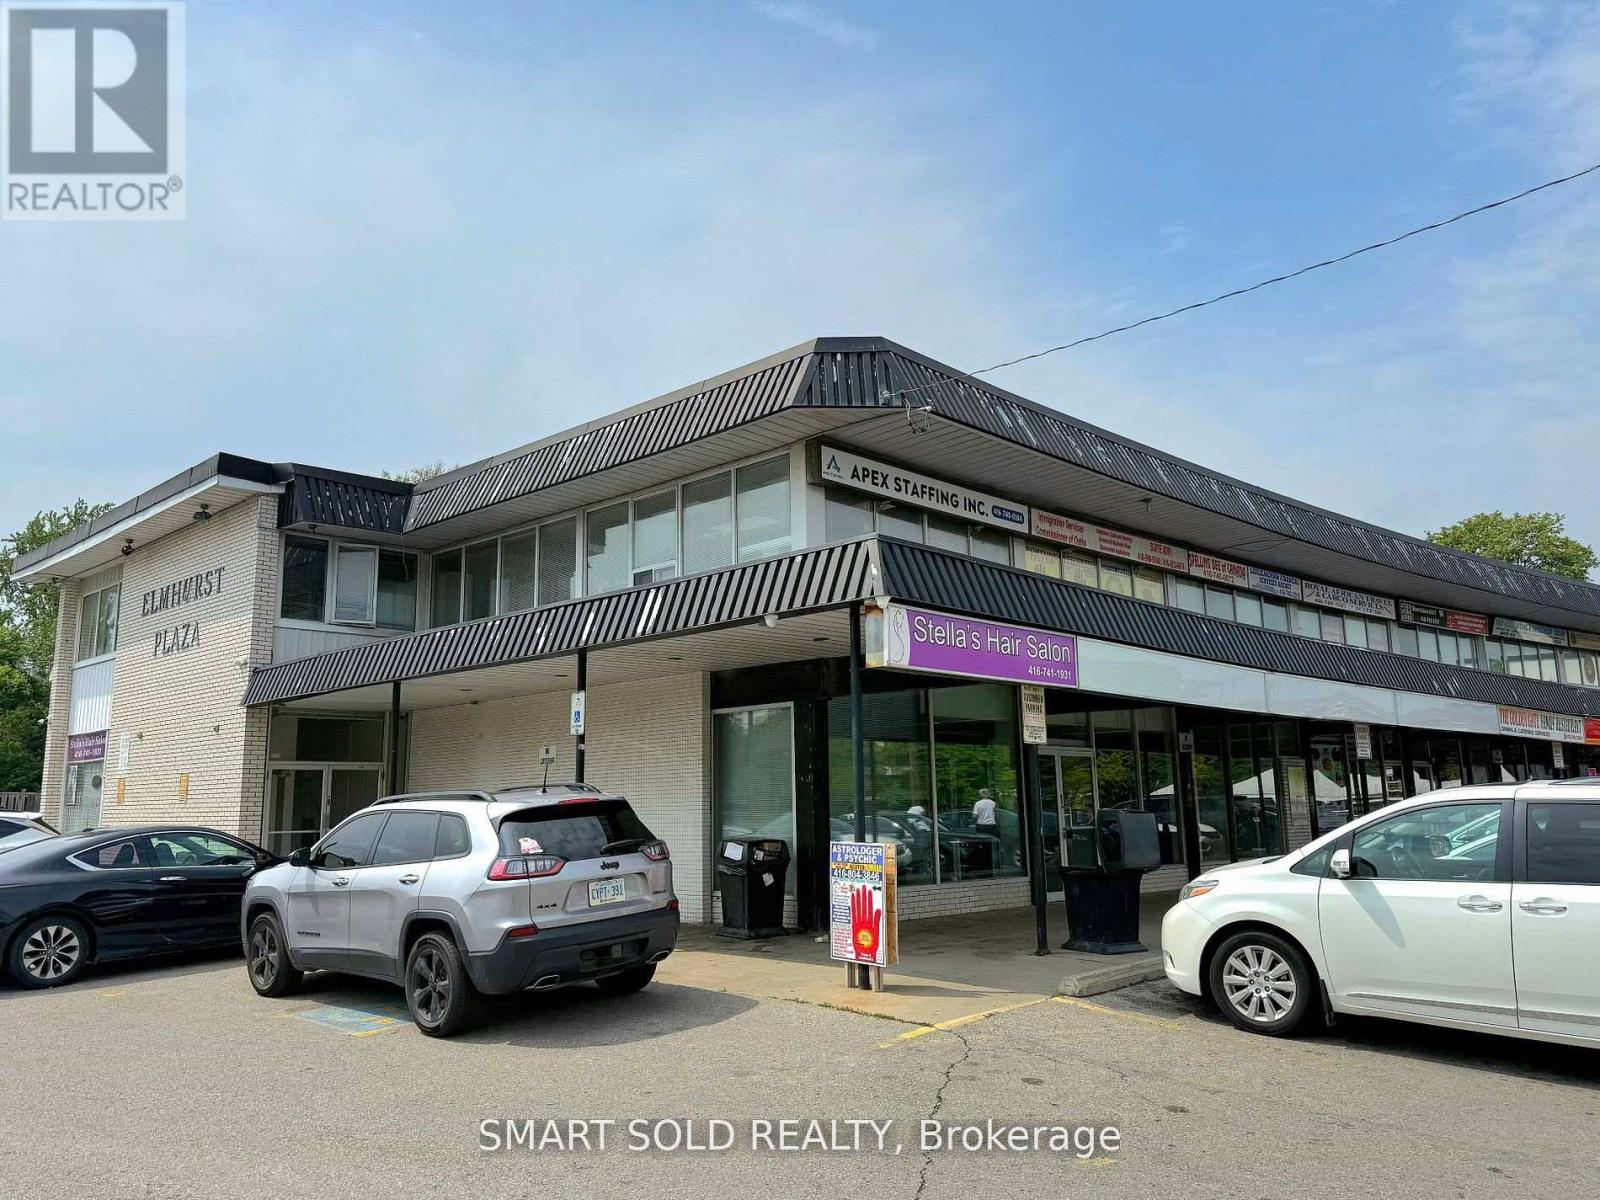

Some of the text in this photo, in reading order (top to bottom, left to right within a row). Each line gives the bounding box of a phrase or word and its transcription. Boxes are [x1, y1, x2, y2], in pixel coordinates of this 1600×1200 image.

[851, 464, 988, 517] APEX STAFFING INC.
[141, 566, 225, 617] ELMHURST
[1304, 582, 1392, 606] ROYAL AFRICAN TRAVEL
[1322, 592, 1348, 604] CARGO
[1349, 599, 1384, 611] SERVICES
[153, 620, 200, 656] PLAZA
[912, 615, 1071, 663] Stella's Hair Salon
[1027, 665, 1072, 680] 416-741-1931
[832, 845, 883, 856] ASTROLOGER
[837, 853, 878, 864] & PSYCHIC
[601, 861, 620, 870] Jeep
